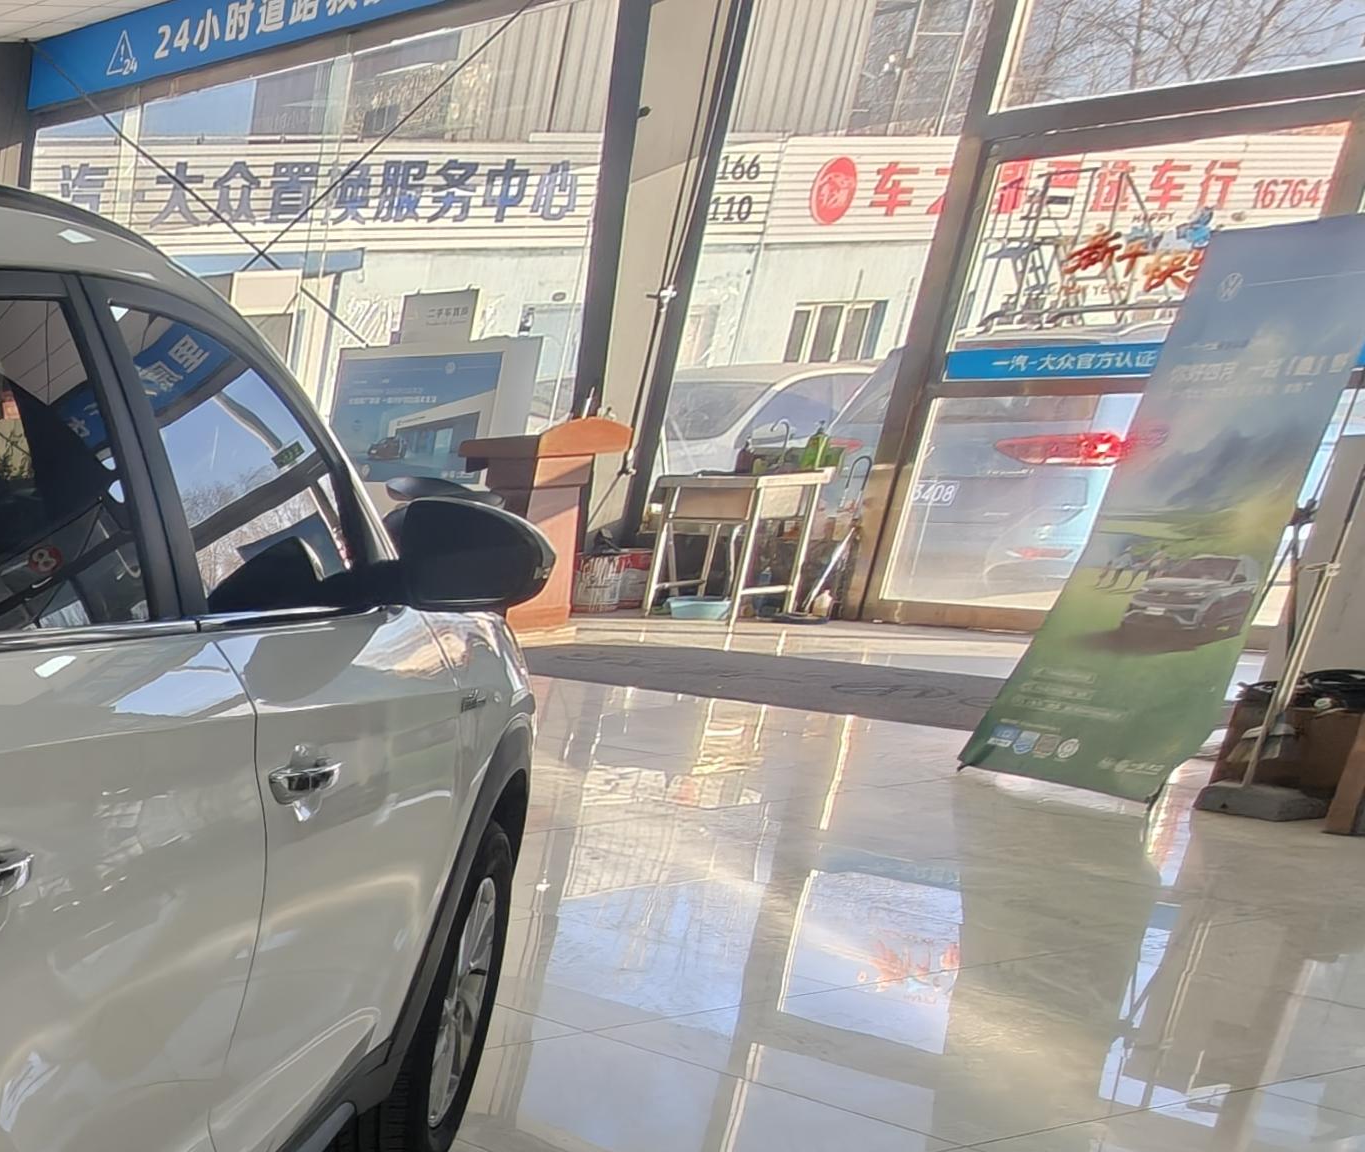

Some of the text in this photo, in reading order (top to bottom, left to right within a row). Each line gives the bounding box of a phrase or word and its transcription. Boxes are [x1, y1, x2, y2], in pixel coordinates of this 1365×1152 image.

[154, 0, 382, 59] 24小时道路
[1252, 179, 1331, 210] 16764
[991, 350, 1157, 371] 一汽-大众官方认证
